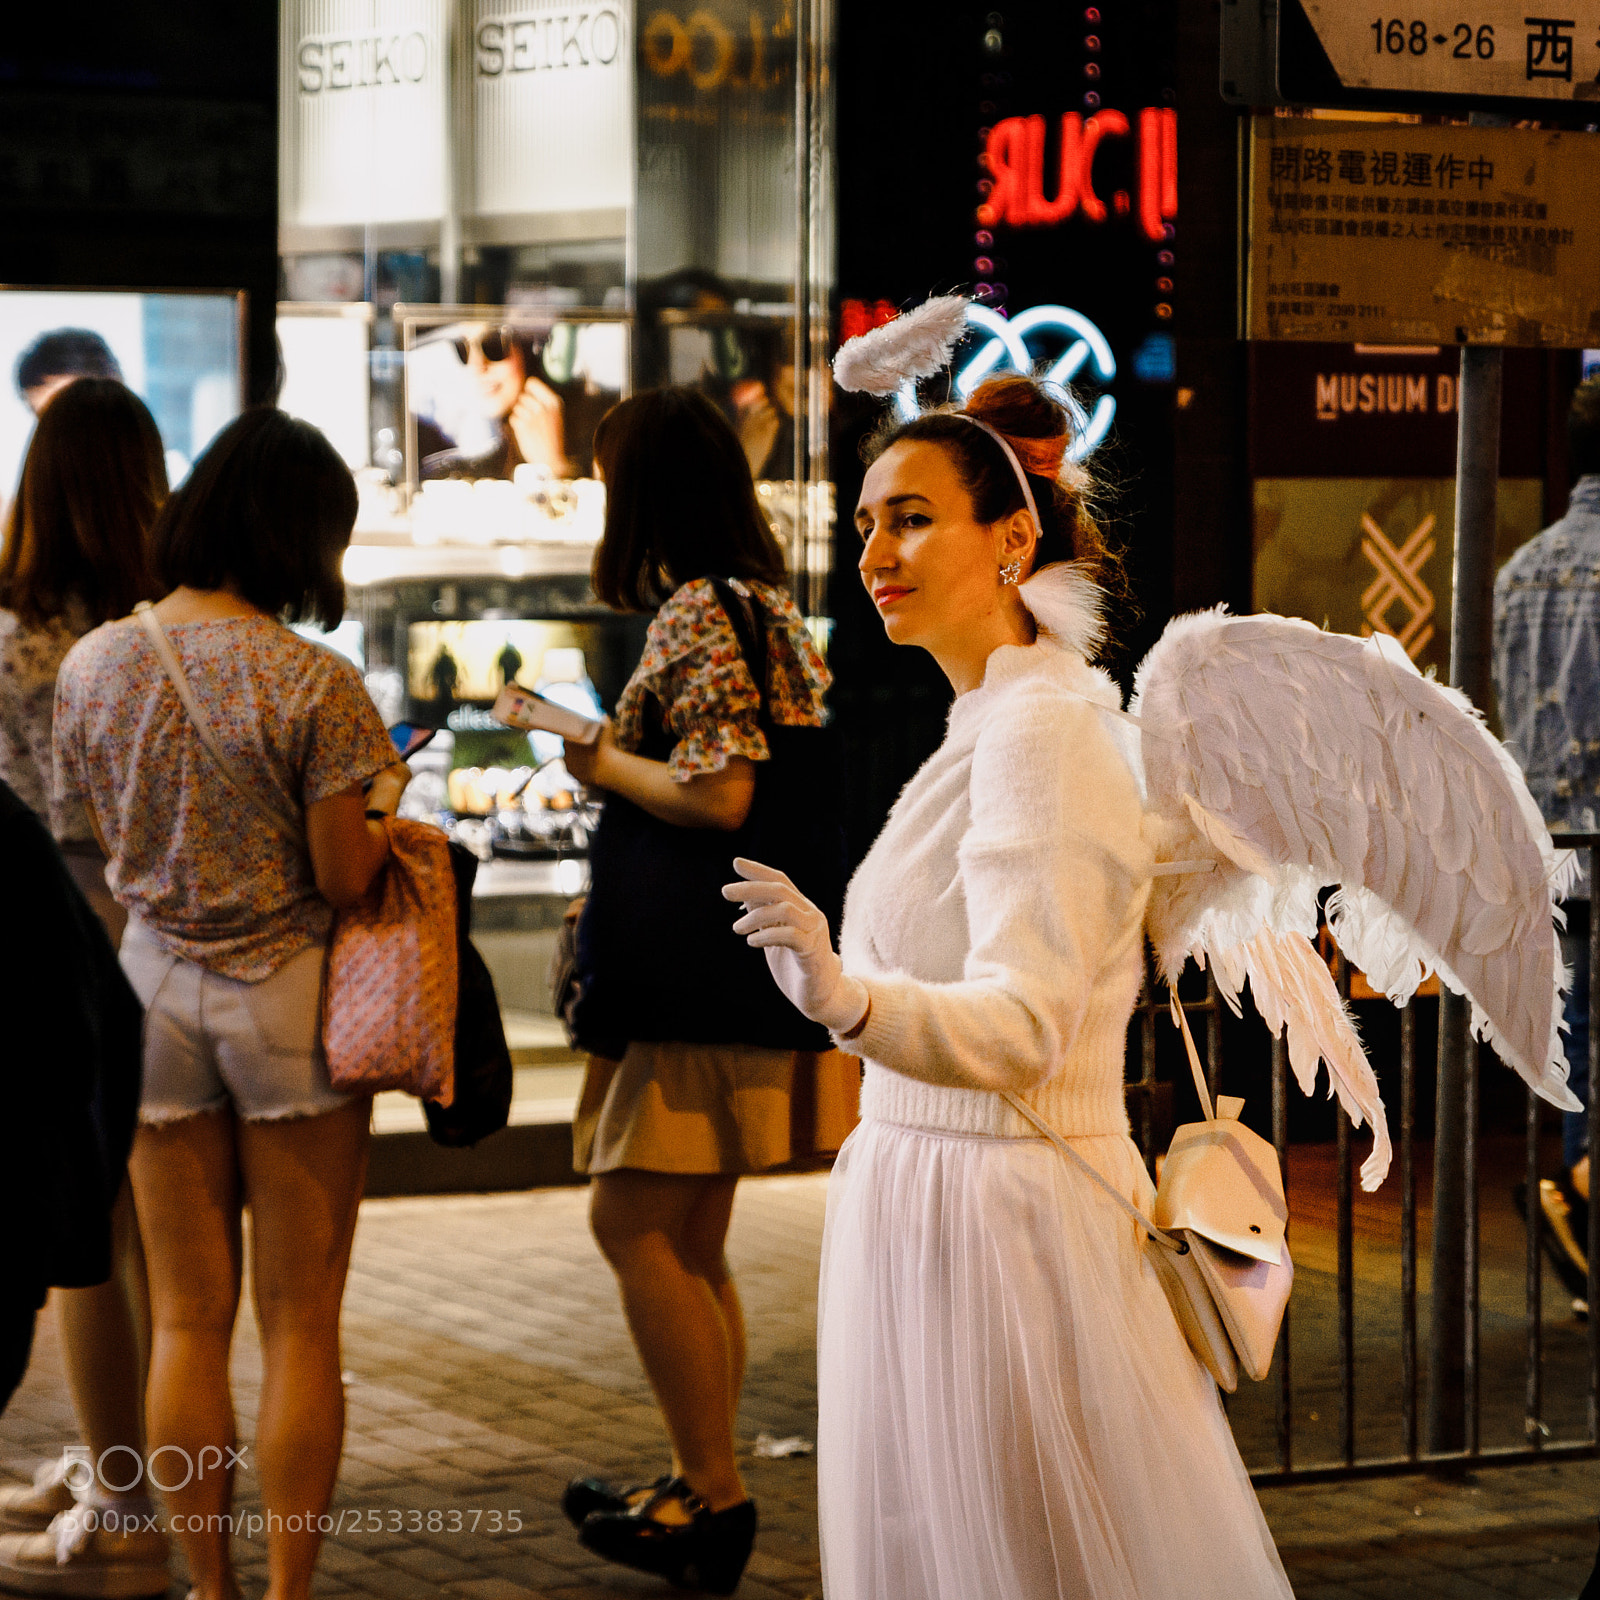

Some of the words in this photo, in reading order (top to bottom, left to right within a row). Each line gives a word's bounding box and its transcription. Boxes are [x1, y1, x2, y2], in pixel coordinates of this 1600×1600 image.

[299, 31, 427, 94] SEIKO
[476, 9, 622, 78] SEIKO
[1524, 17, 1600, 82] 西
[1269, 146, 1495, 190] 閉路電視運作中
[1316, 374, 1428, 420] MUSIUM
